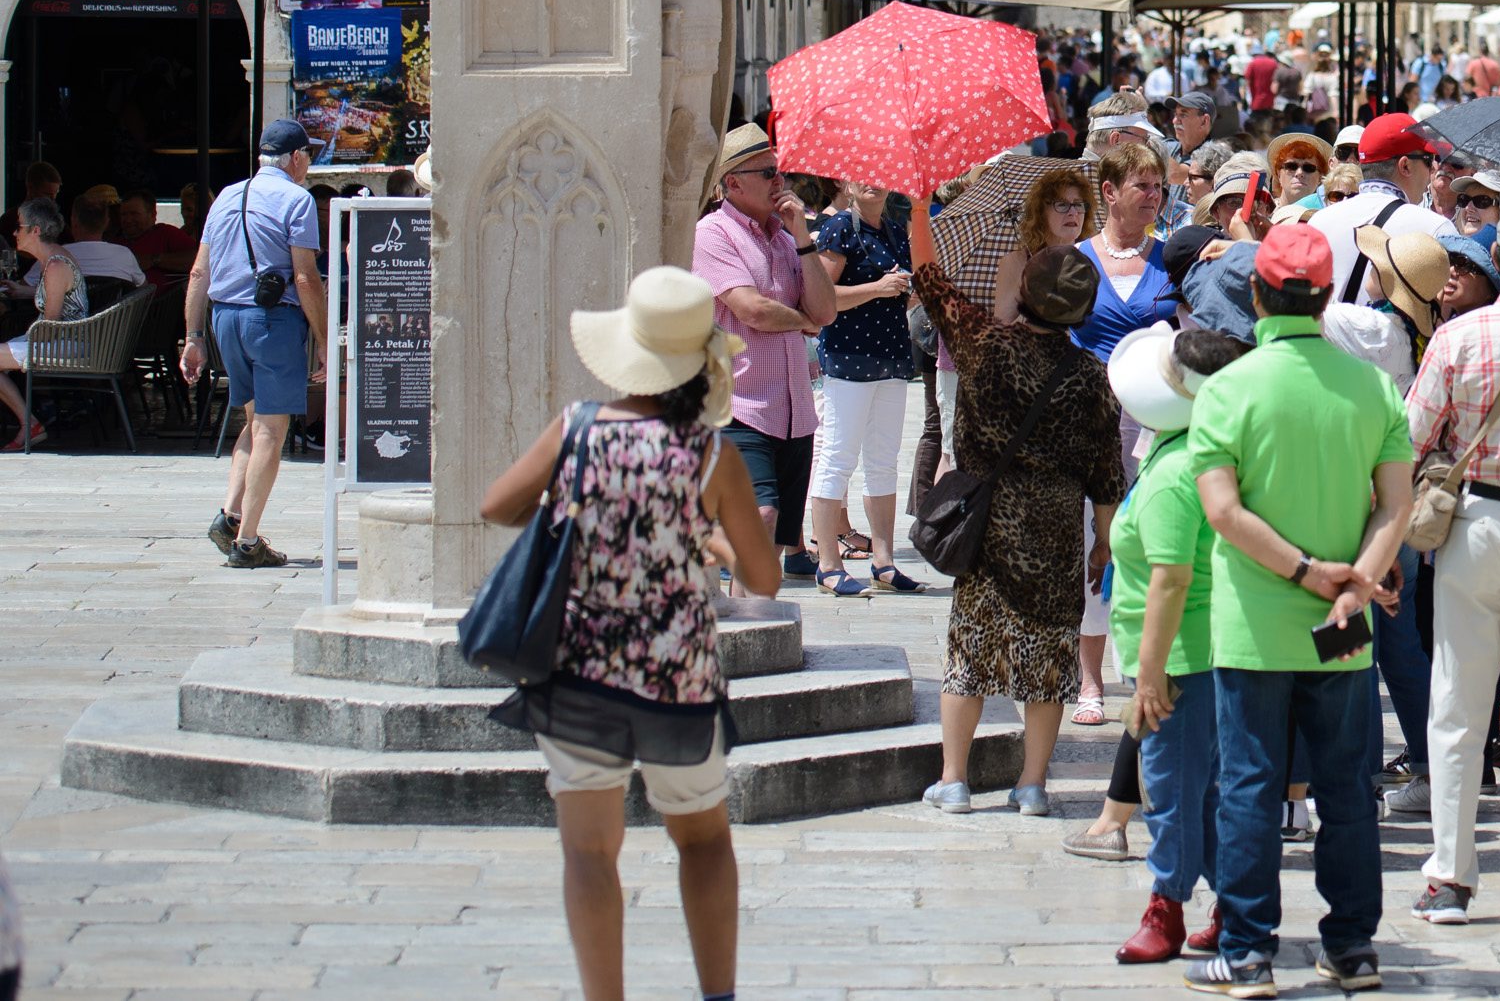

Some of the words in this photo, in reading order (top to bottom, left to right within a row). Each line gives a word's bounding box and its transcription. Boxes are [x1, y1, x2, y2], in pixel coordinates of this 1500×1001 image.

[82, 4, 121, 12] DELICIOUS
[133, 4, 177, 12] REFRESHING
[365, 259, 389, 268] 30.5.
[392, 258, 425, 267] Utorak
[365, 340, 384, 348] 2.6.
[386, 340, 414, 348] Petak
